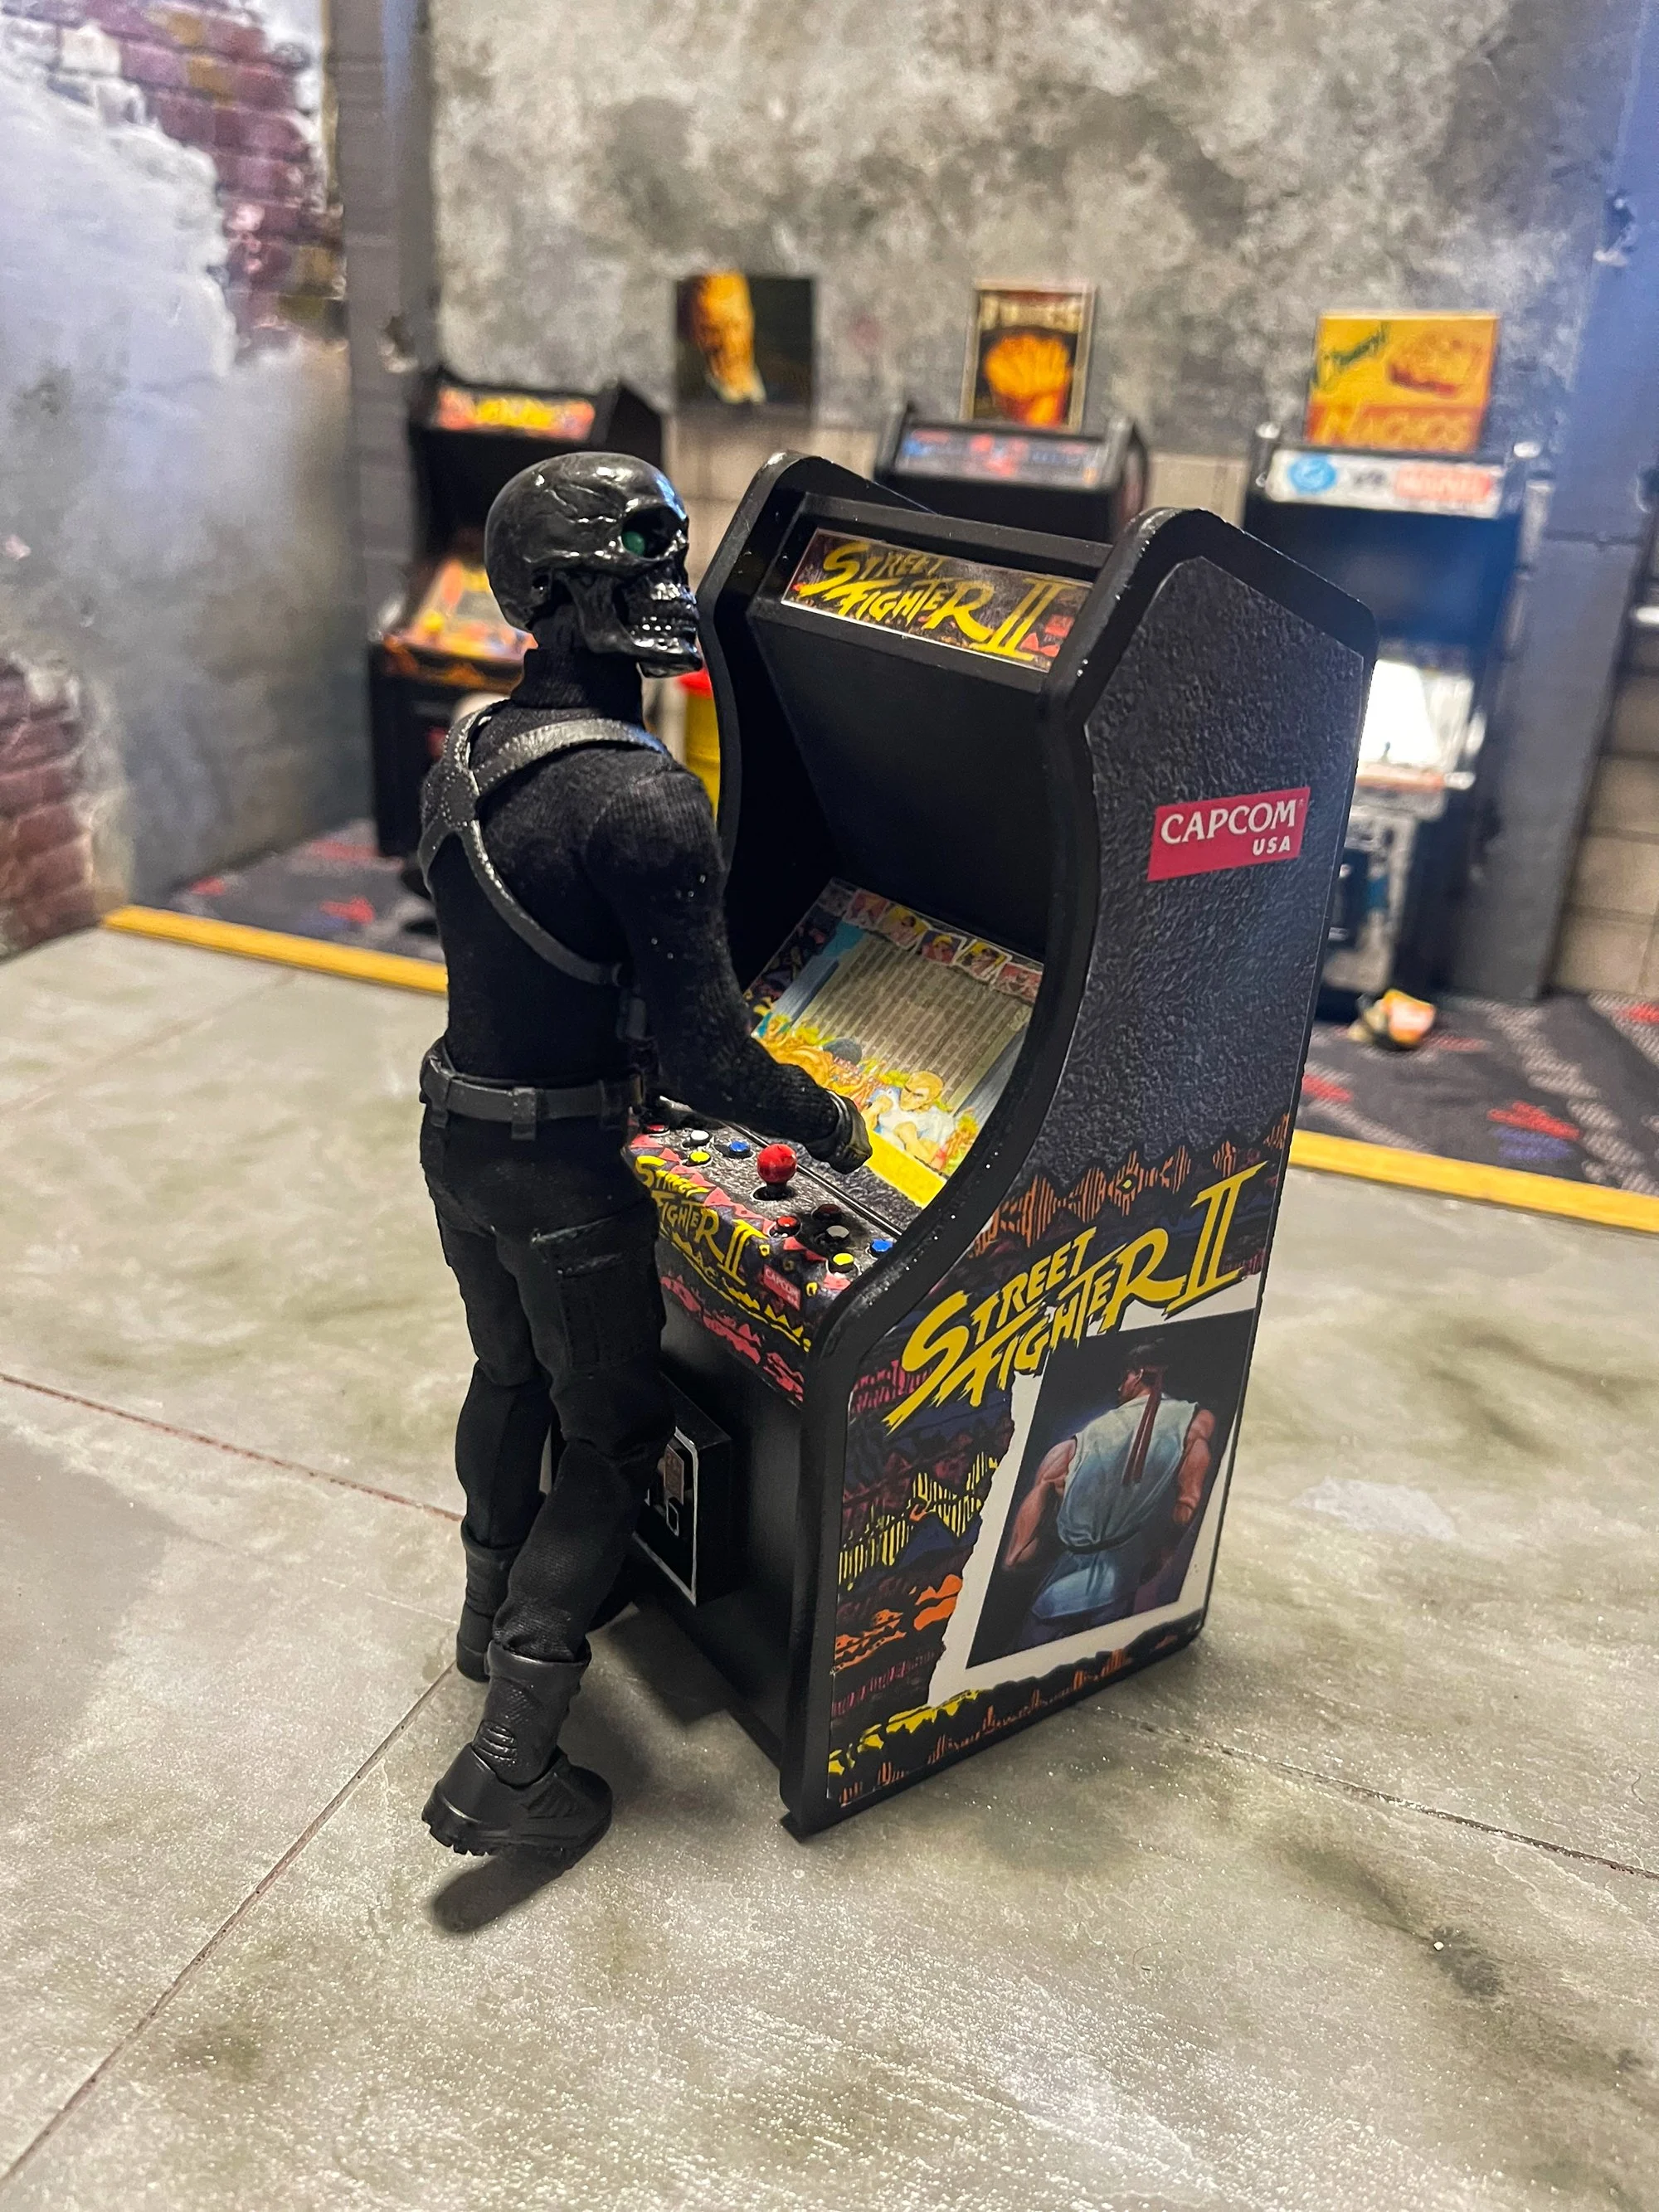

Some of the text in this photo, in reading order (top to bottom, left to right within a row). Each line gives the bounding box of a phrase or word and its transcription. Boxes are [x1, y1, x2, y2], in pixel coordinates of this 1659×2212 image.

[799, 542, 944, 598] STREET
[821, 577, 1078, 661] FIGHTER II
[1160, 799, 1296, 844] CAPCOM
[1253, 836, 1291, 856] USA
[635, 1155, 710, 1198] STREET
[651, 1190, 725, 1262] FIGHTER
[929, 1160, 1268, 1408] FIGHTER II
[882, 1227, 1097, 1437] STREET
